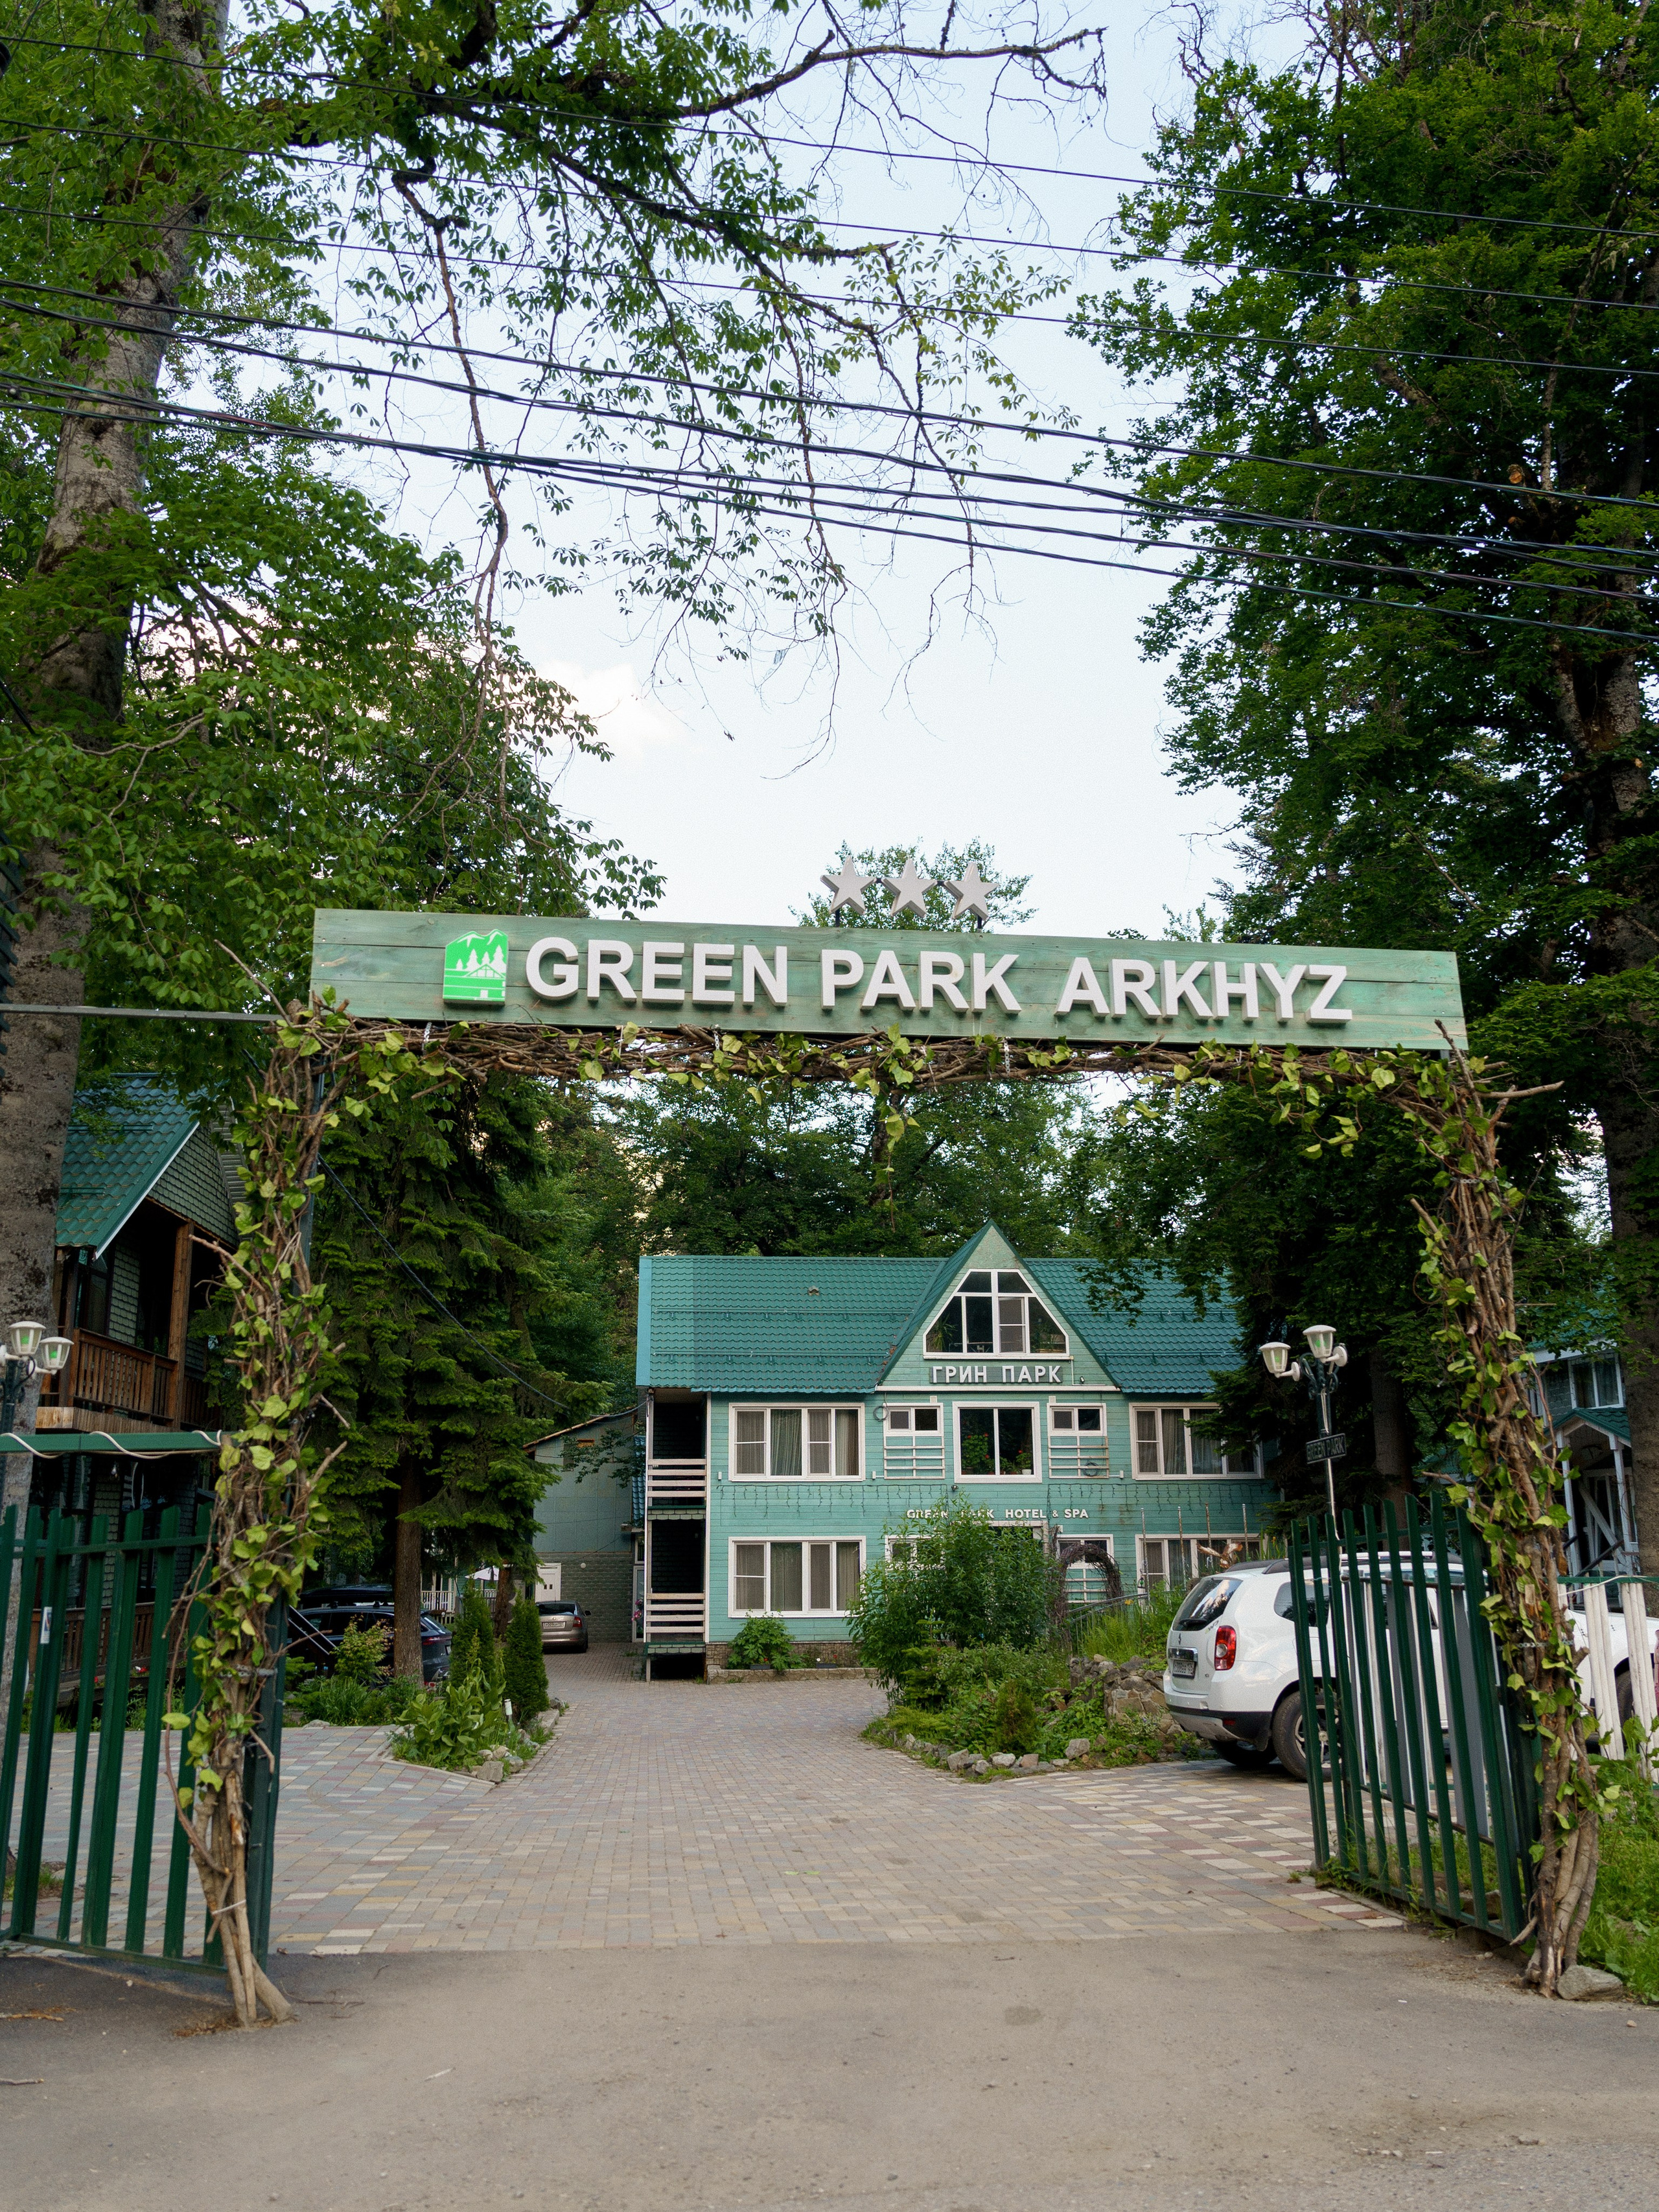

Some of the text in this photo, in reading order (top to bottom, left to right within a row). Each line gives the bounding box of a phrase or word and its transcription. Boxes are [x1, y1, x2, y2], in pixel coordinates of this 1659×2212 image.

[526, 937, 1353, 1025] GREEN PARK ARKHYZ
[933, 1365, 1062, 1384] ГРИН ПАРК
[1005, 1509, 1047, 1519] HOTEL
[1052, 1509, 1059, 1518] &
[1064, 1508, 1089, 1519] SPA
